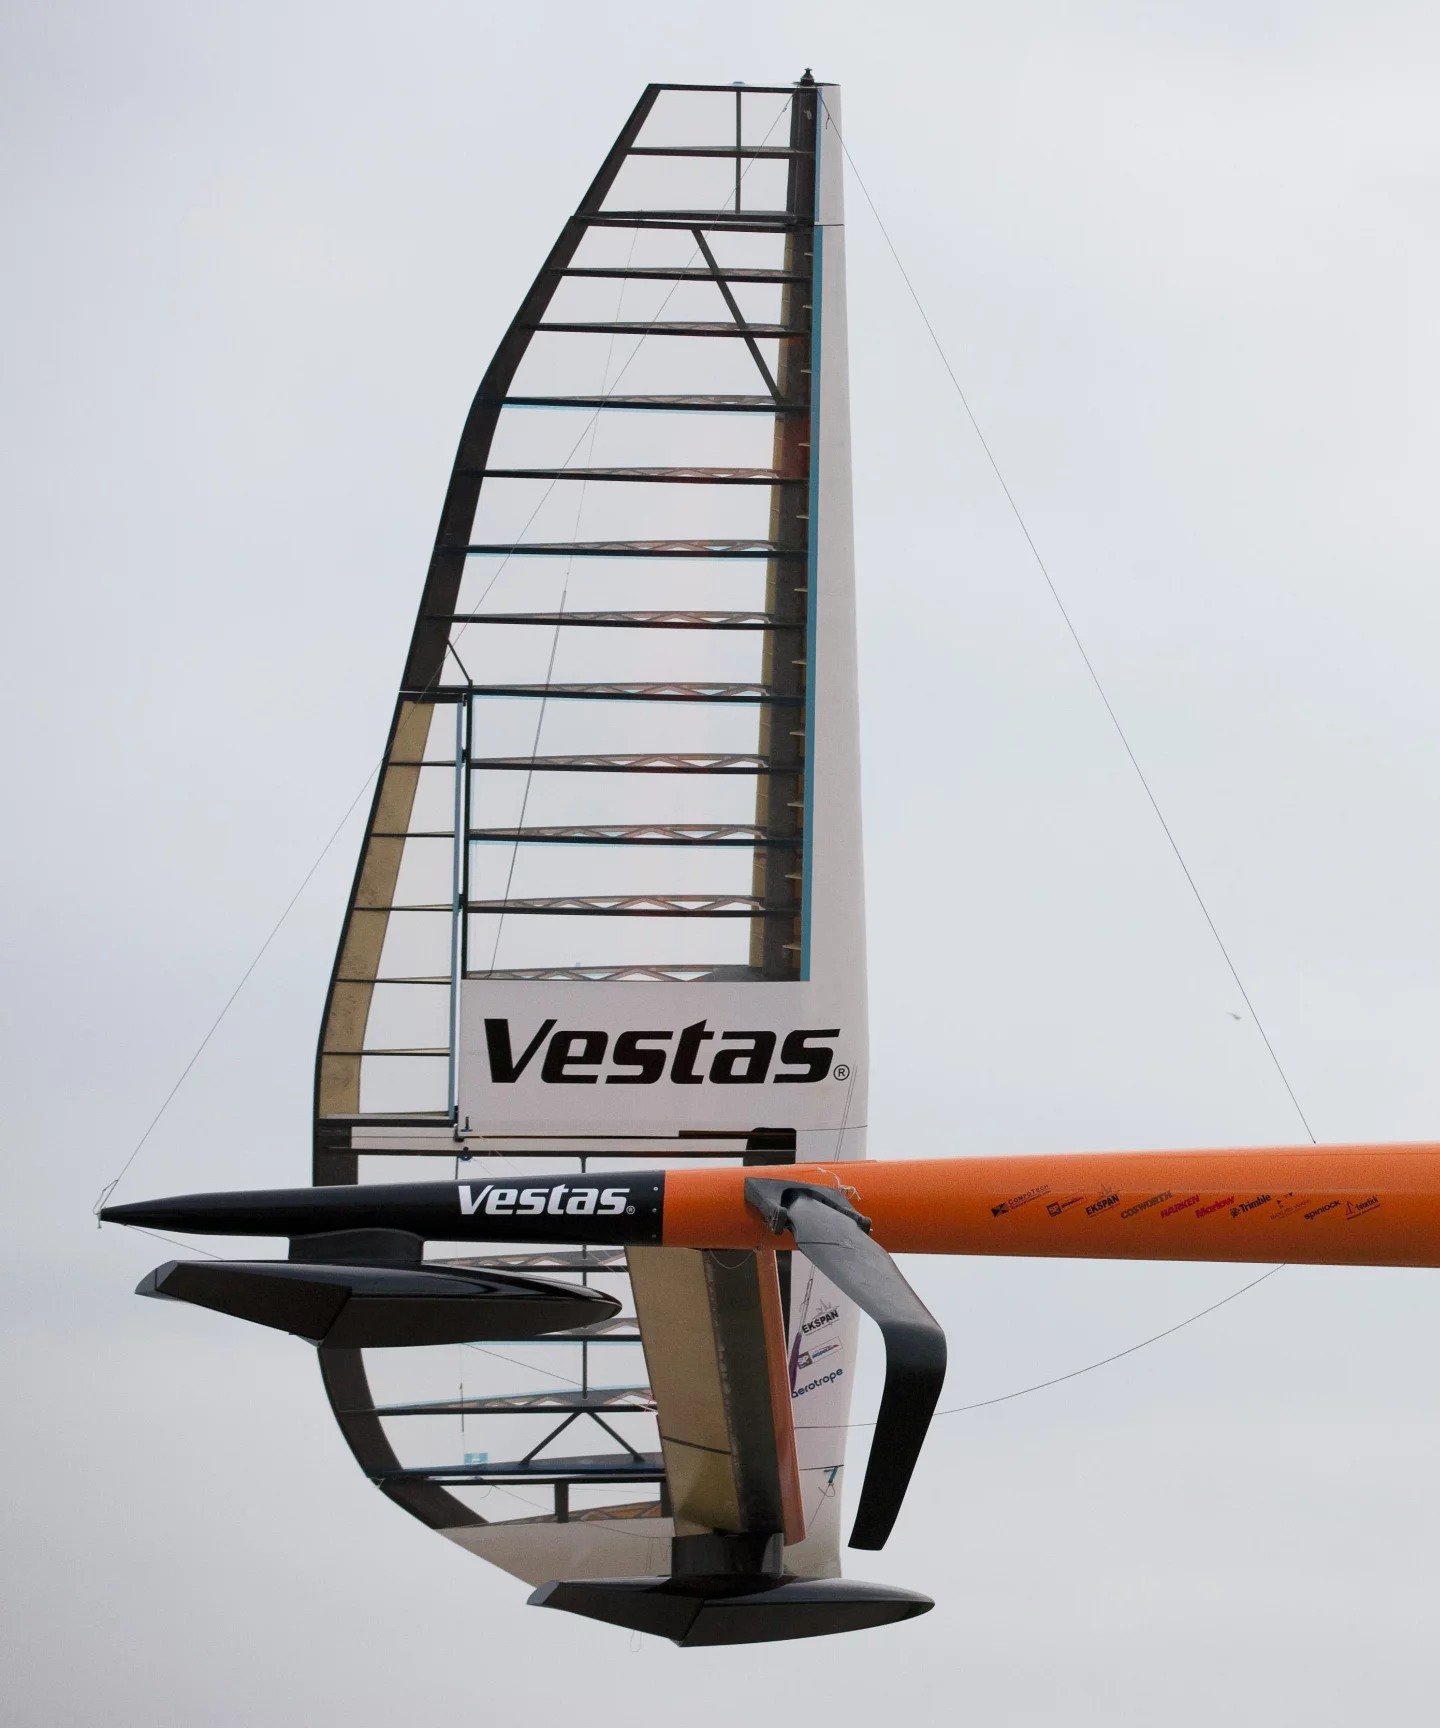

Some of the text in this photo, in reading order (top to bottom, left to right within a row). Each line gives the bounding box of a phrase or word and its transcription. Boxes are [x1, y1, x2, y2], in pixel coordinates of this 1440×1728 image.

[1085, 1194, 1120, 1216] EKSPAN
[1120, 1190, 1173, 1219] COSWORTH
[1160, 1194, 1200, 1219] HARKEN
[1195, 1196, 1235, 1219] Marlow
[1239, 1194, 1271, 1213] Trimble
[801, 1309, 839, 1334] EKSPAN
[791, 1368, 843, 1399] aerotrope
